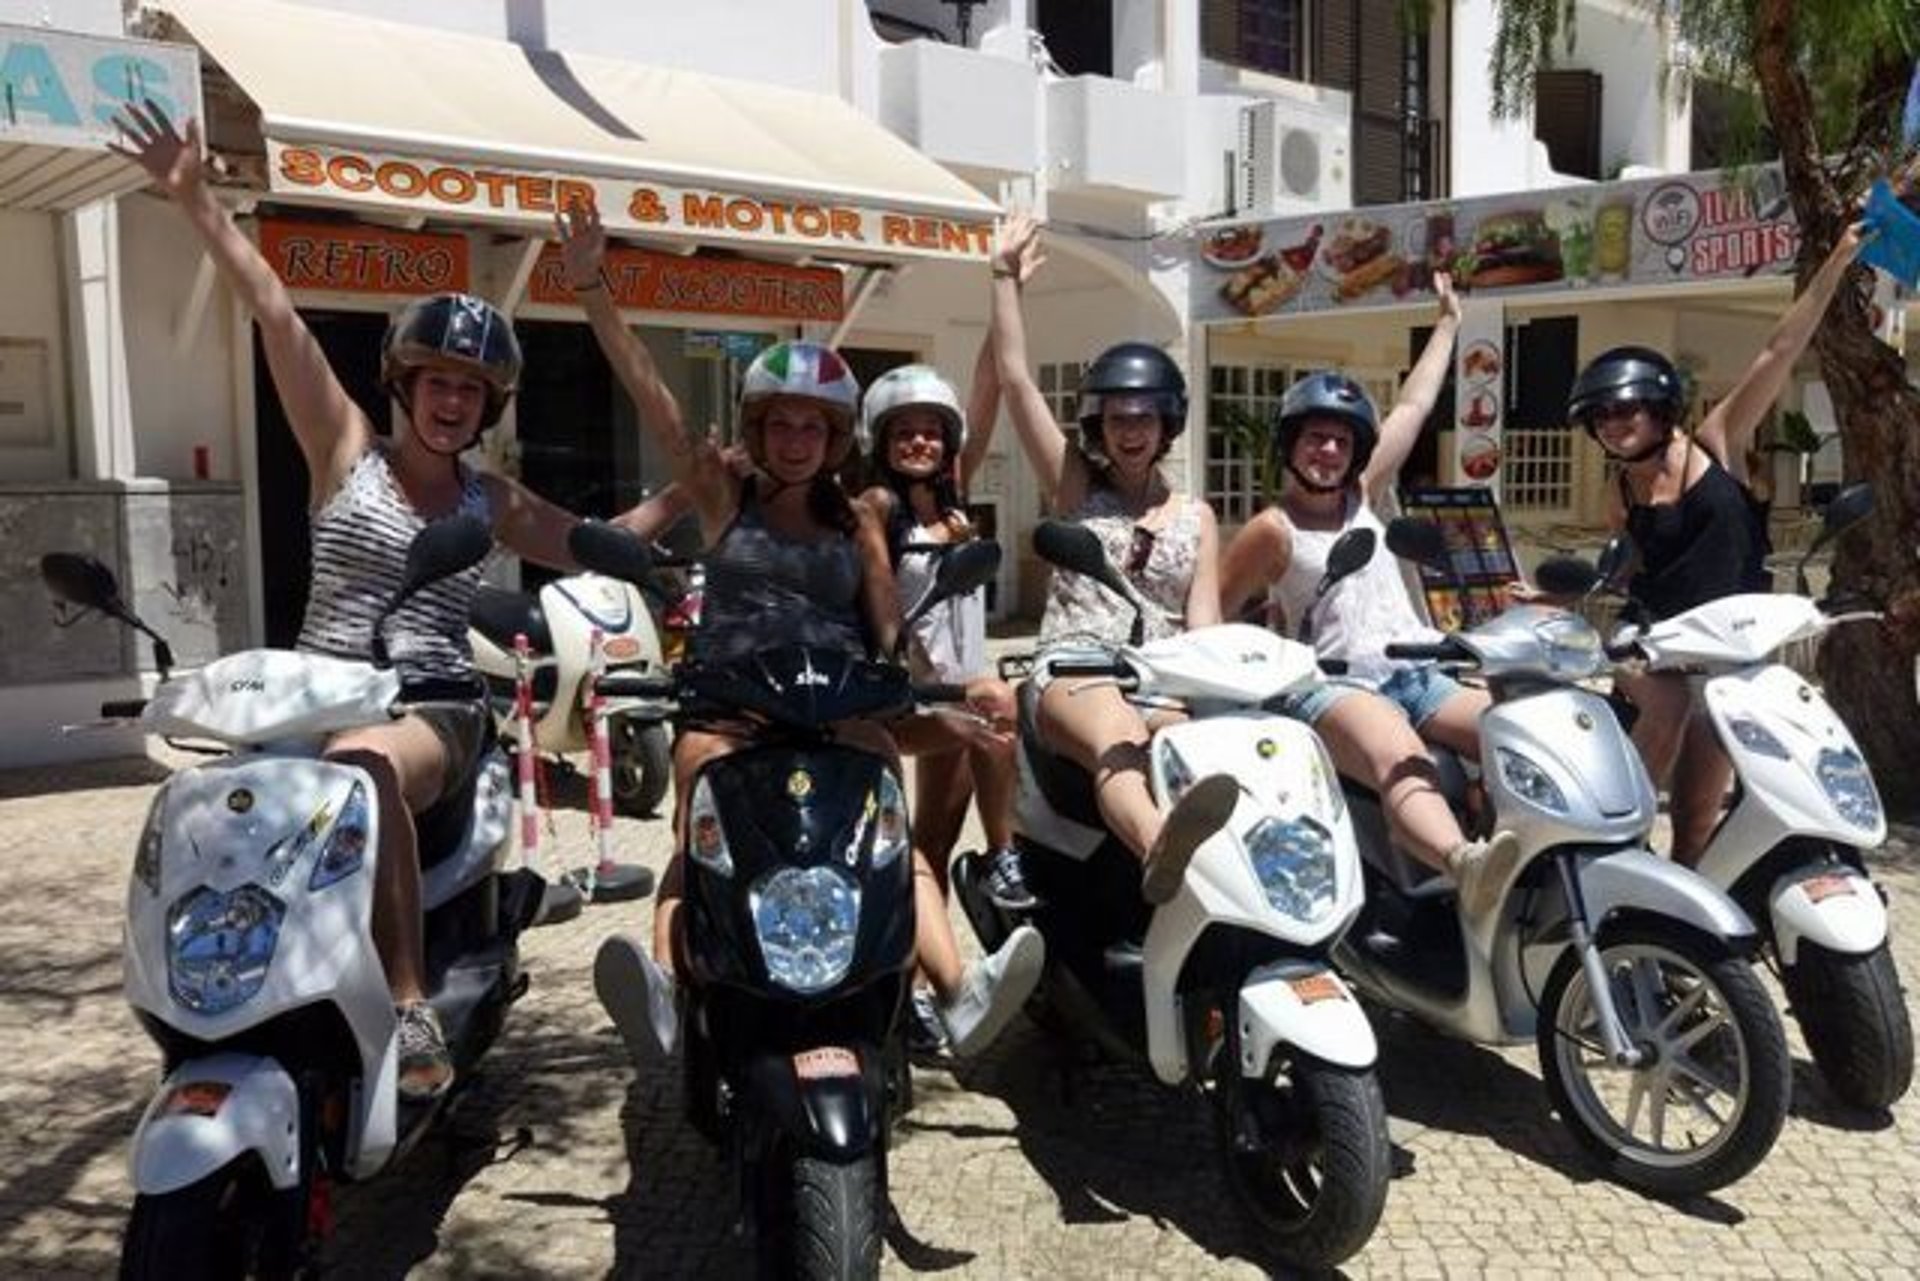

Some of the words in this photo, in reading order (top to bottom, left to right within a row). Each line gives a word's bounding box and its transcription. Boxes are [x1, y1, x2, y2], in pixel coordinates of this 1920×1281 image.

[279, 149, 597, 216] SCOOTER
[627, 187, 670, 223] &
[682, 193, 865, 241] MOTOR
[880, 214, 994, 254] RENT
[281, 239, 454, 289] RETRO
[1691, 223, 1793, 276] SPORTS
[540, 258, 648, 298] RNT
[653, 263, 840, 315] SCOOTERS
